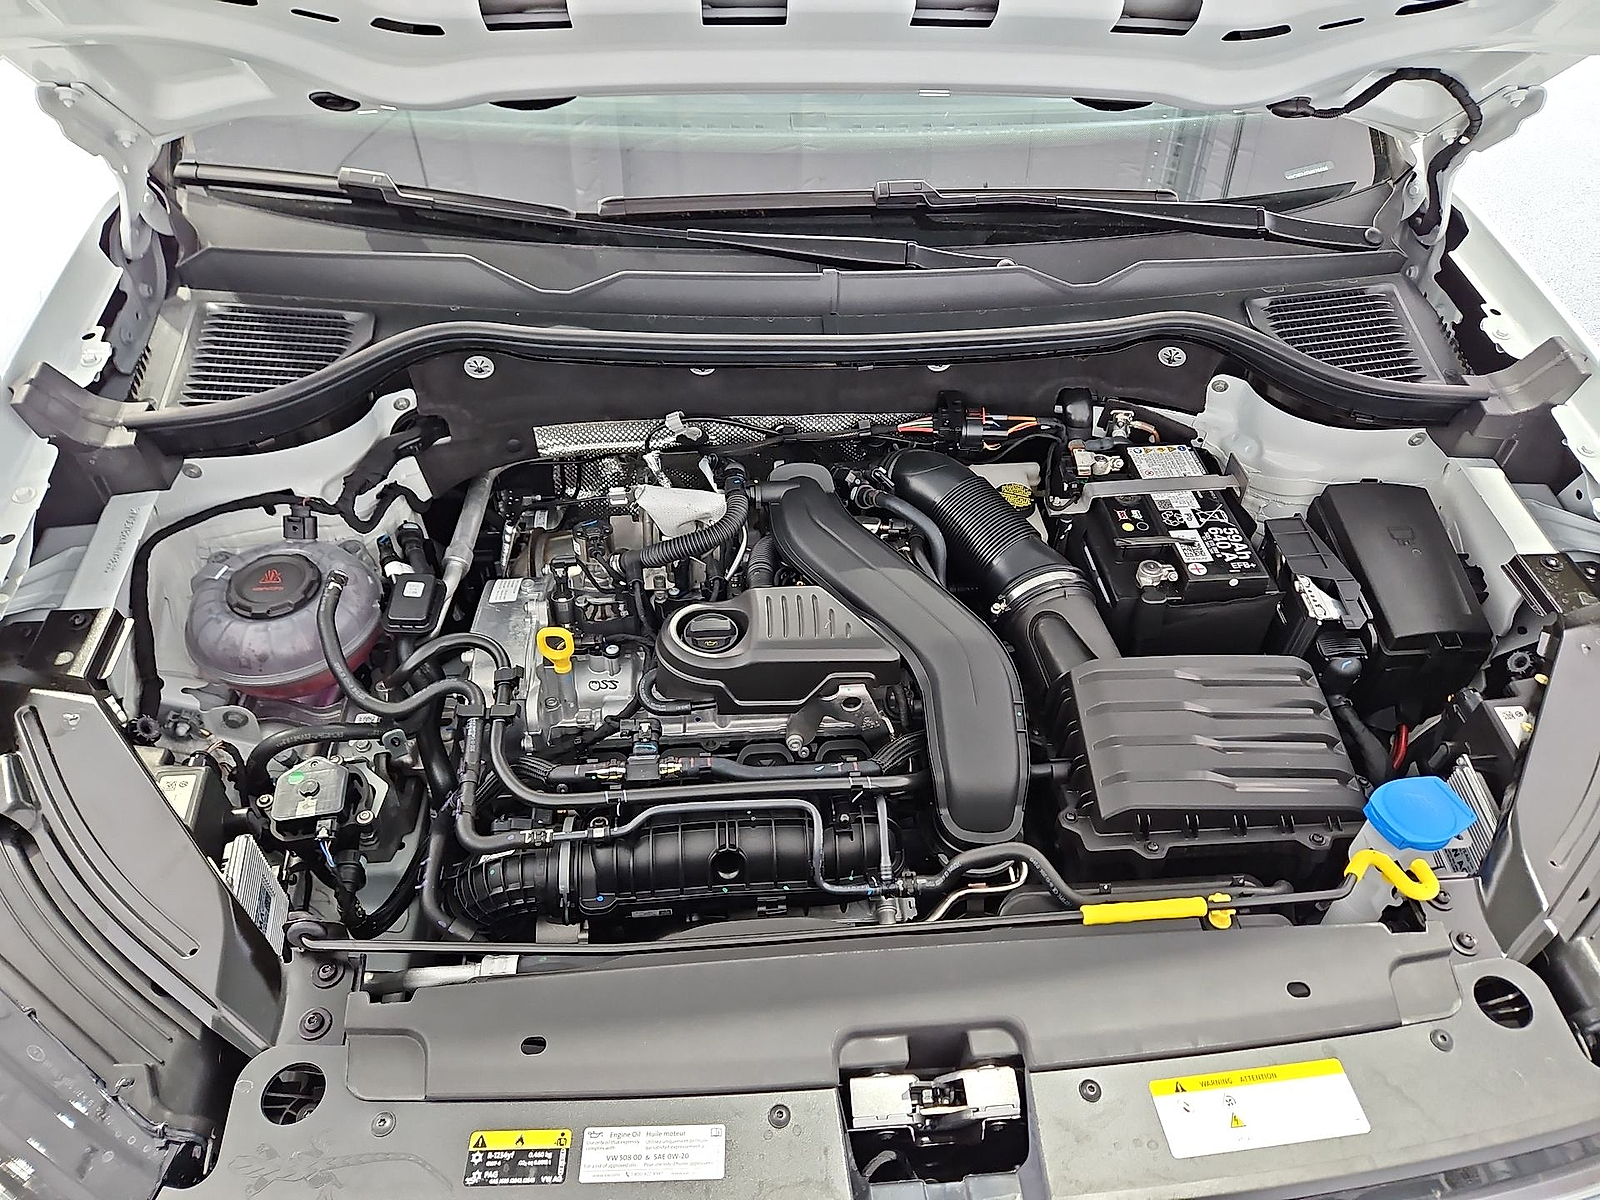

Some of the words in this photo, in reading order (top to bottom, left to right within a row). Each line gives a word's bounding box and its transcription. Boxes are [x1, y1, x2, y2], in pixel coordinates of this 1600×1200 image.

[1207, 526, 1232, 549] 640
[1223, 527, 1252, 560] 59Ah
[1230, 561, 1257, 569] EFB+
[1199, 1077, 1233, 1088] WARNING
[1239, 1072, 1278, 1083] ATTENTION
[609, 1131, 631, 1140] Engine
[646, 1130, 663, 1138] Huile
[666, 1152, 690, 1160] 0W-20
[483, 1170, 499, 1179] PAG
[540, 1175, 552, 1183] VW
